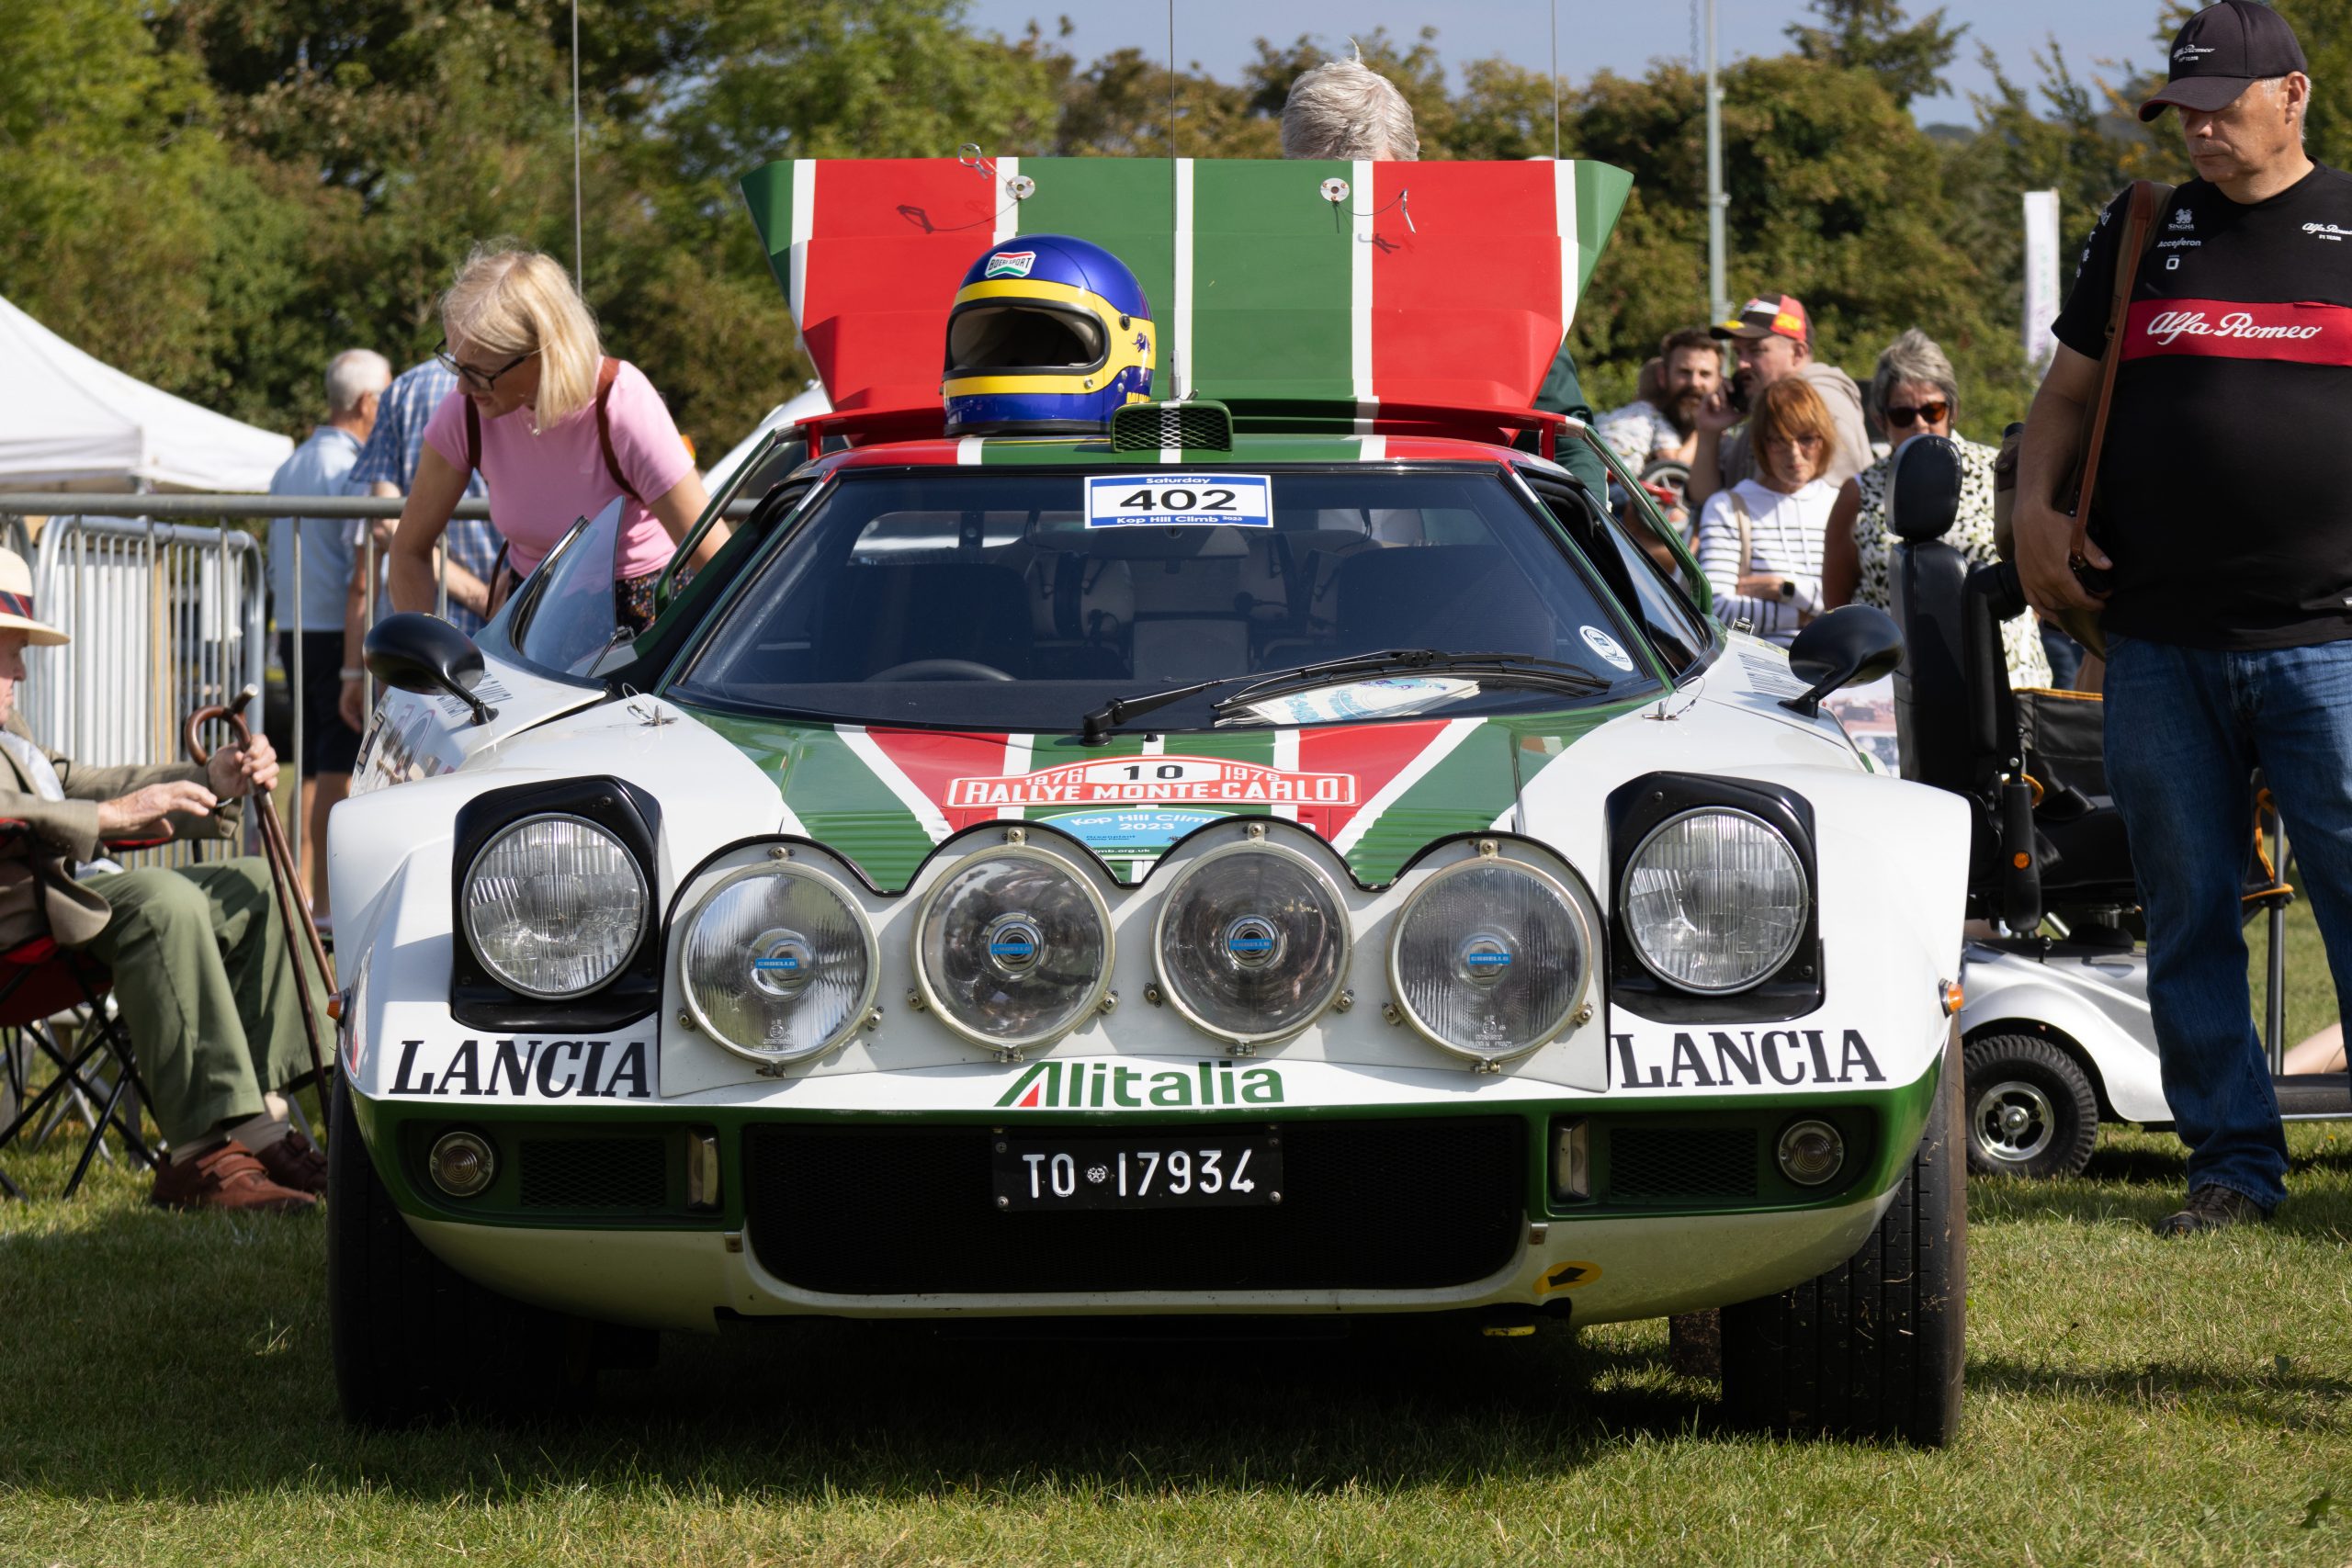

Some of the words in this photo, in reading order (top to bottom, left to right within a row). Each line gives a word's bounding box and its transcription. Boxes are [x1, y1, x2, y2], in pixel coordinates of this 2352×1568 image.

[2301, 222, 2325, 234] Alfa
[2146, 311, 2214, 345] Alfa
[2213, 311, 2323, 340] Romeo
[1146, 477, 1211, 485] Saturday
[1119, 489, 1238, 512] 402
[1116, 516, 1147, 525] Kop
[1174, 515, 1219, 524] Climb
[1023, 767, 1085, 786] 1976
[1123, 764, 1184, 781] 10
[1223, 765, 1282, 782] 1976
[964, 781, 1081, 805] RALLYE
[1069, 816, 1114, 826] Kop
[1117, 814, 1149, 822] Hill
[1117, 822, 1175, 830] 2023
[387, 1039, 652, 1100] LANCIA
[1611, 1029, 1887, 1089] LANCIA
[993, 1059, 1285, 1108] Alitalia
[1022, 1152, 1077, 1199] TO
[1118, 1148, 1256, 1197] 17934
